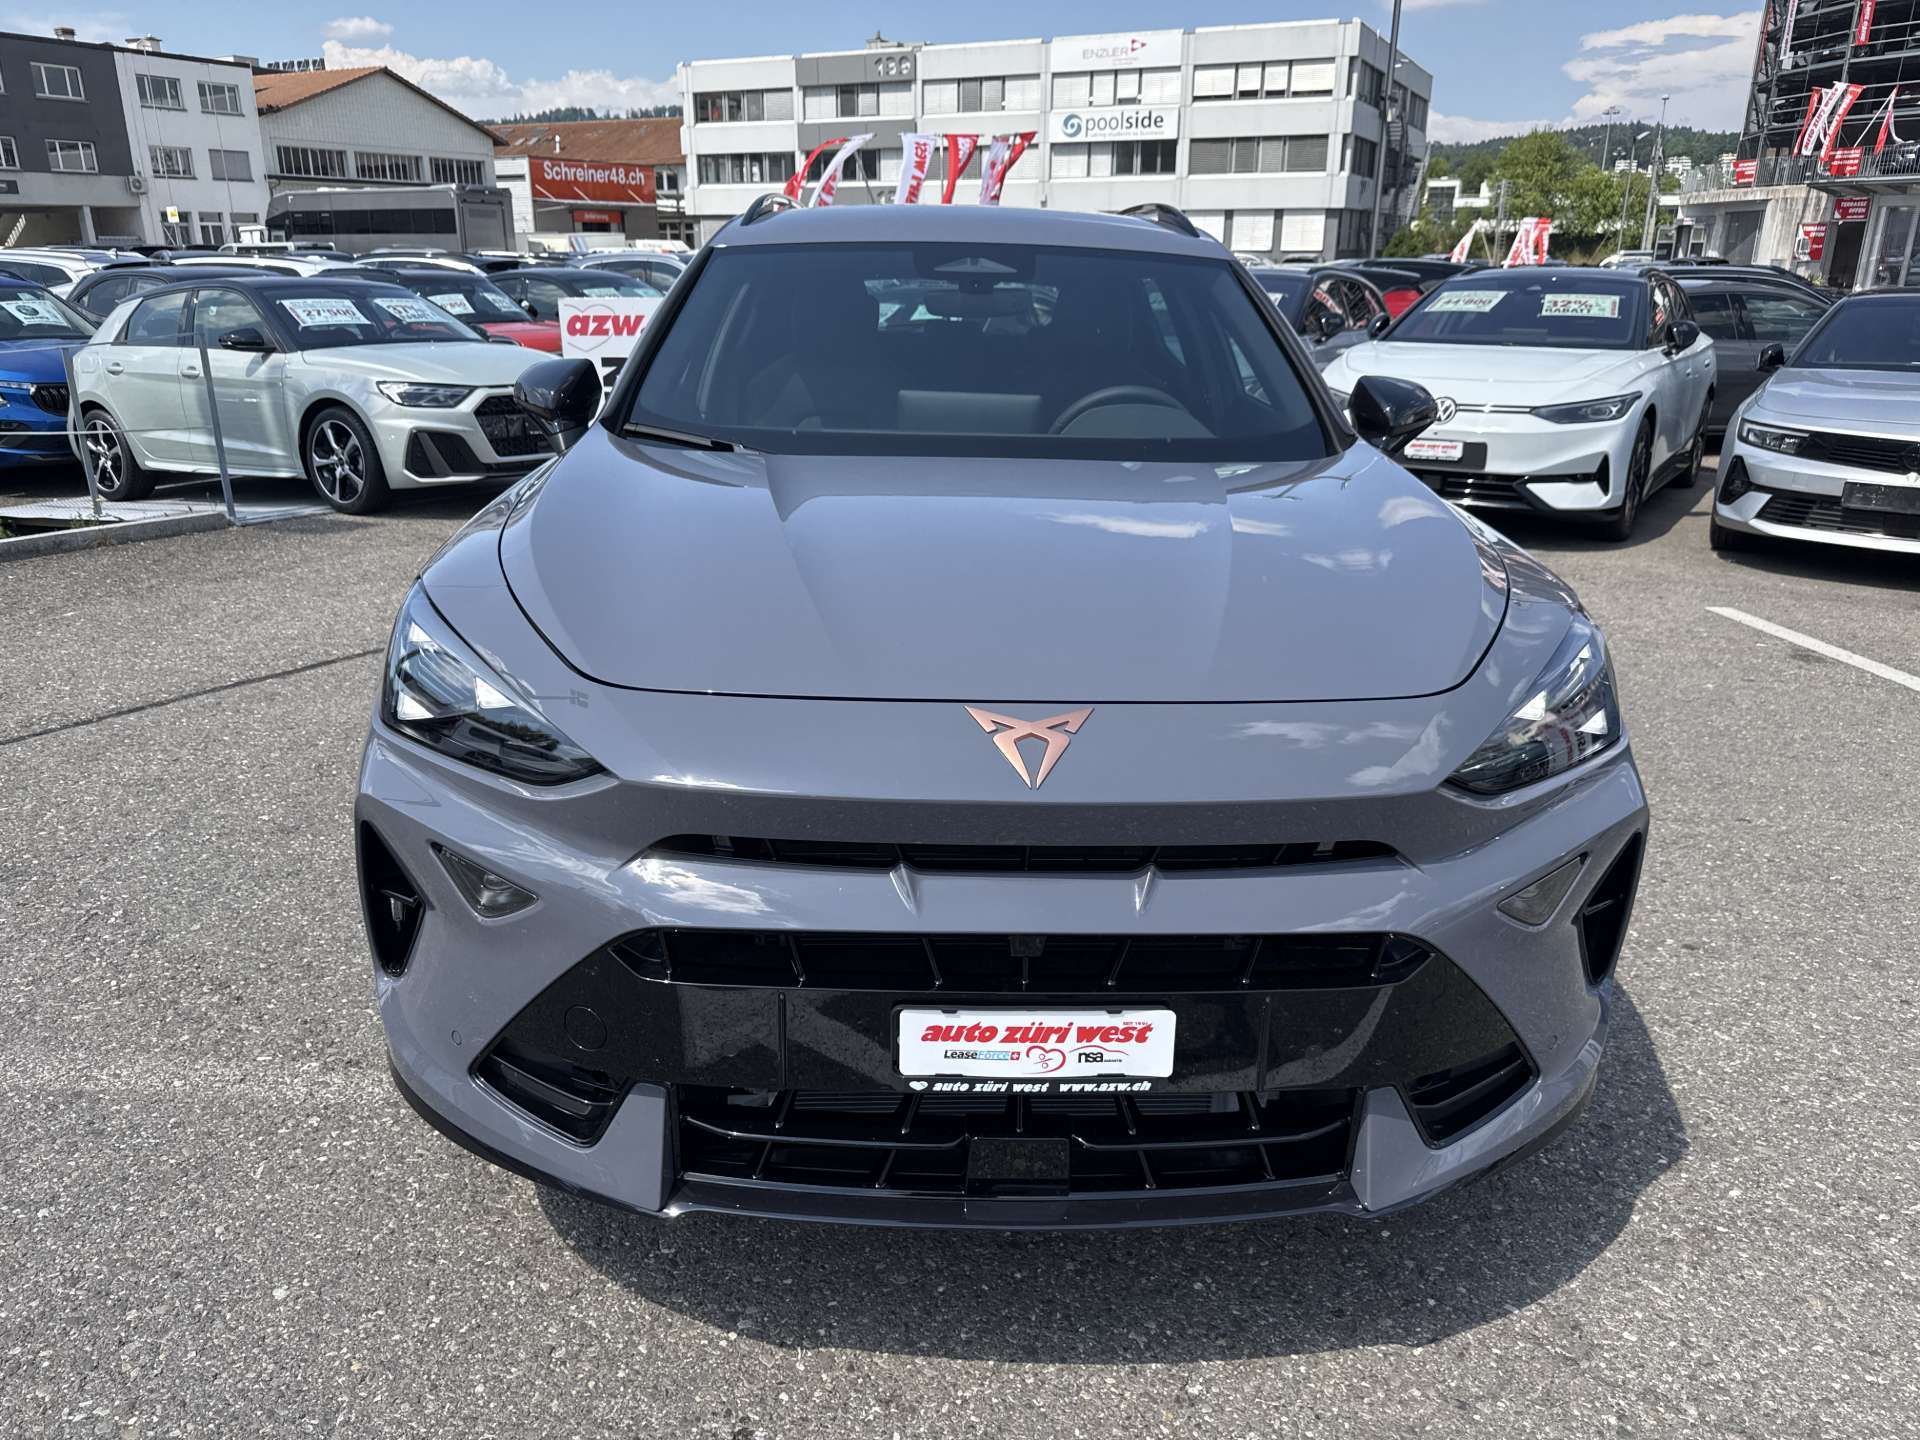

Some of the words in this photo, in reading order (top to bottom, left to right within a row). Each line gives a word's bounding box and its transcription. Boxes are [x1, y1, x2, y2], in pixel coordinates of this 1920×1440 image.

[1082, 47, 1129, 60] ENZLER
[1085, 110, 1164, 138] poolside
[543, 160, 645, 185] Schreiner48.ch
[921, 1021, 998, 1042] auto
[999, 1022, 1074, 1043] züri
[1076, 1023, 1153, 1043] west
[944, 1050, 1010, 1060] LeaseForce
[1078, 1052, 1104, 1063] nsa
[932, 1081, 969, 1092] auto
[972, 1081, 1008, 1092] züri
[1012, 1082, 1050, 1092] west
[1059, 1081, 1151, 1092] www.azw.ch
